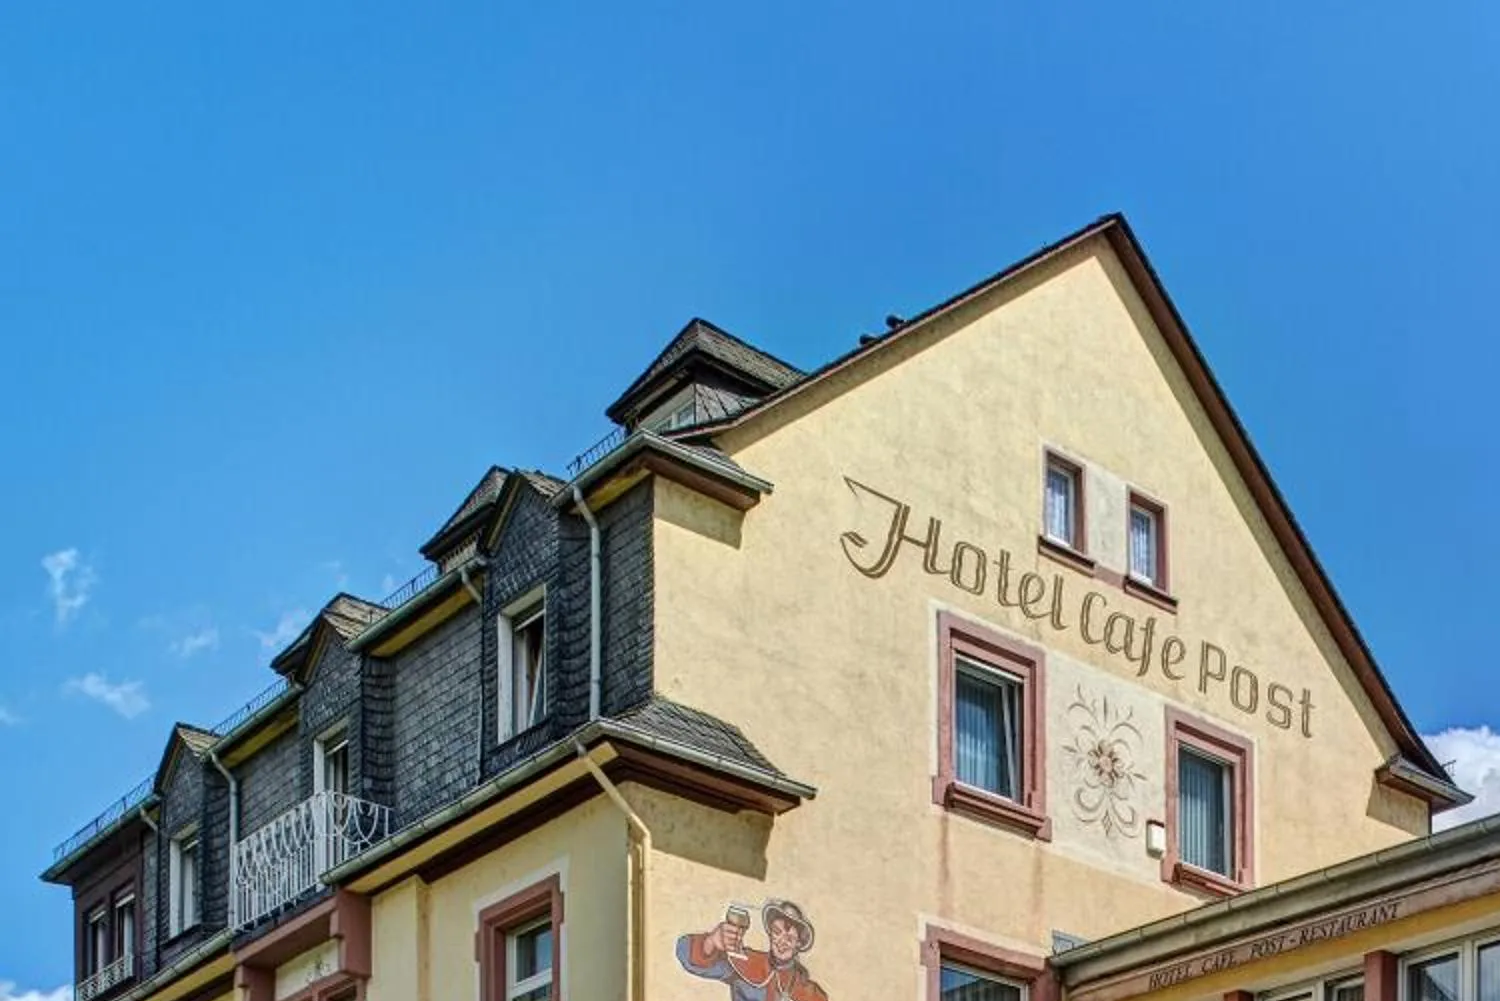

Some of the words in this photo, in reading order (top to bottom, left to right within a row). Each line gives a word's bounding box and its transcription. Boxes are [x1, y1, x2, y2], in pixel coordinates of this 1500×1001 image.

[840, 475, 1068, 631] Hotel
[1080, 590, 1187, 681] Cafe
[1197, 640, 1317, 739] Post
[1148, 964, 1194, 991] HOTEL
